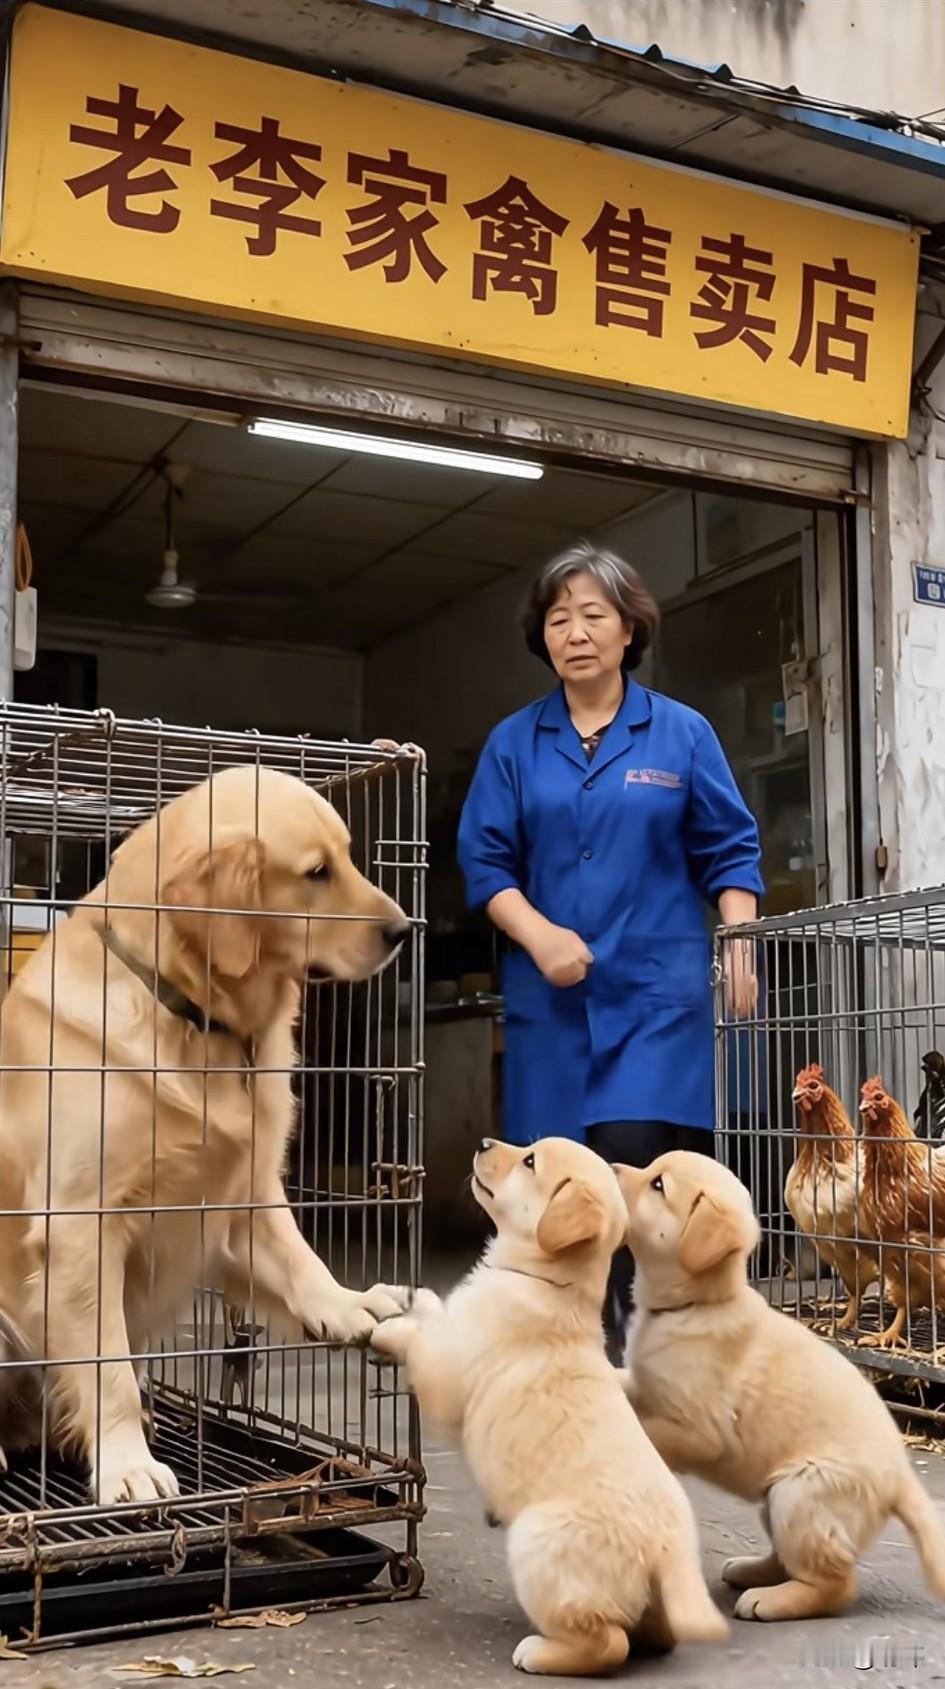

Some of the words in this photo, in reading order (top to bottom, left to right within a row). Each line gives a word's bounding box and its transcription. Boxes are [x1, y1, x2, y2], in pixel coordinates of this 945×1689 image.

[64, 83, 877, 382] 老李家禽售卖店
